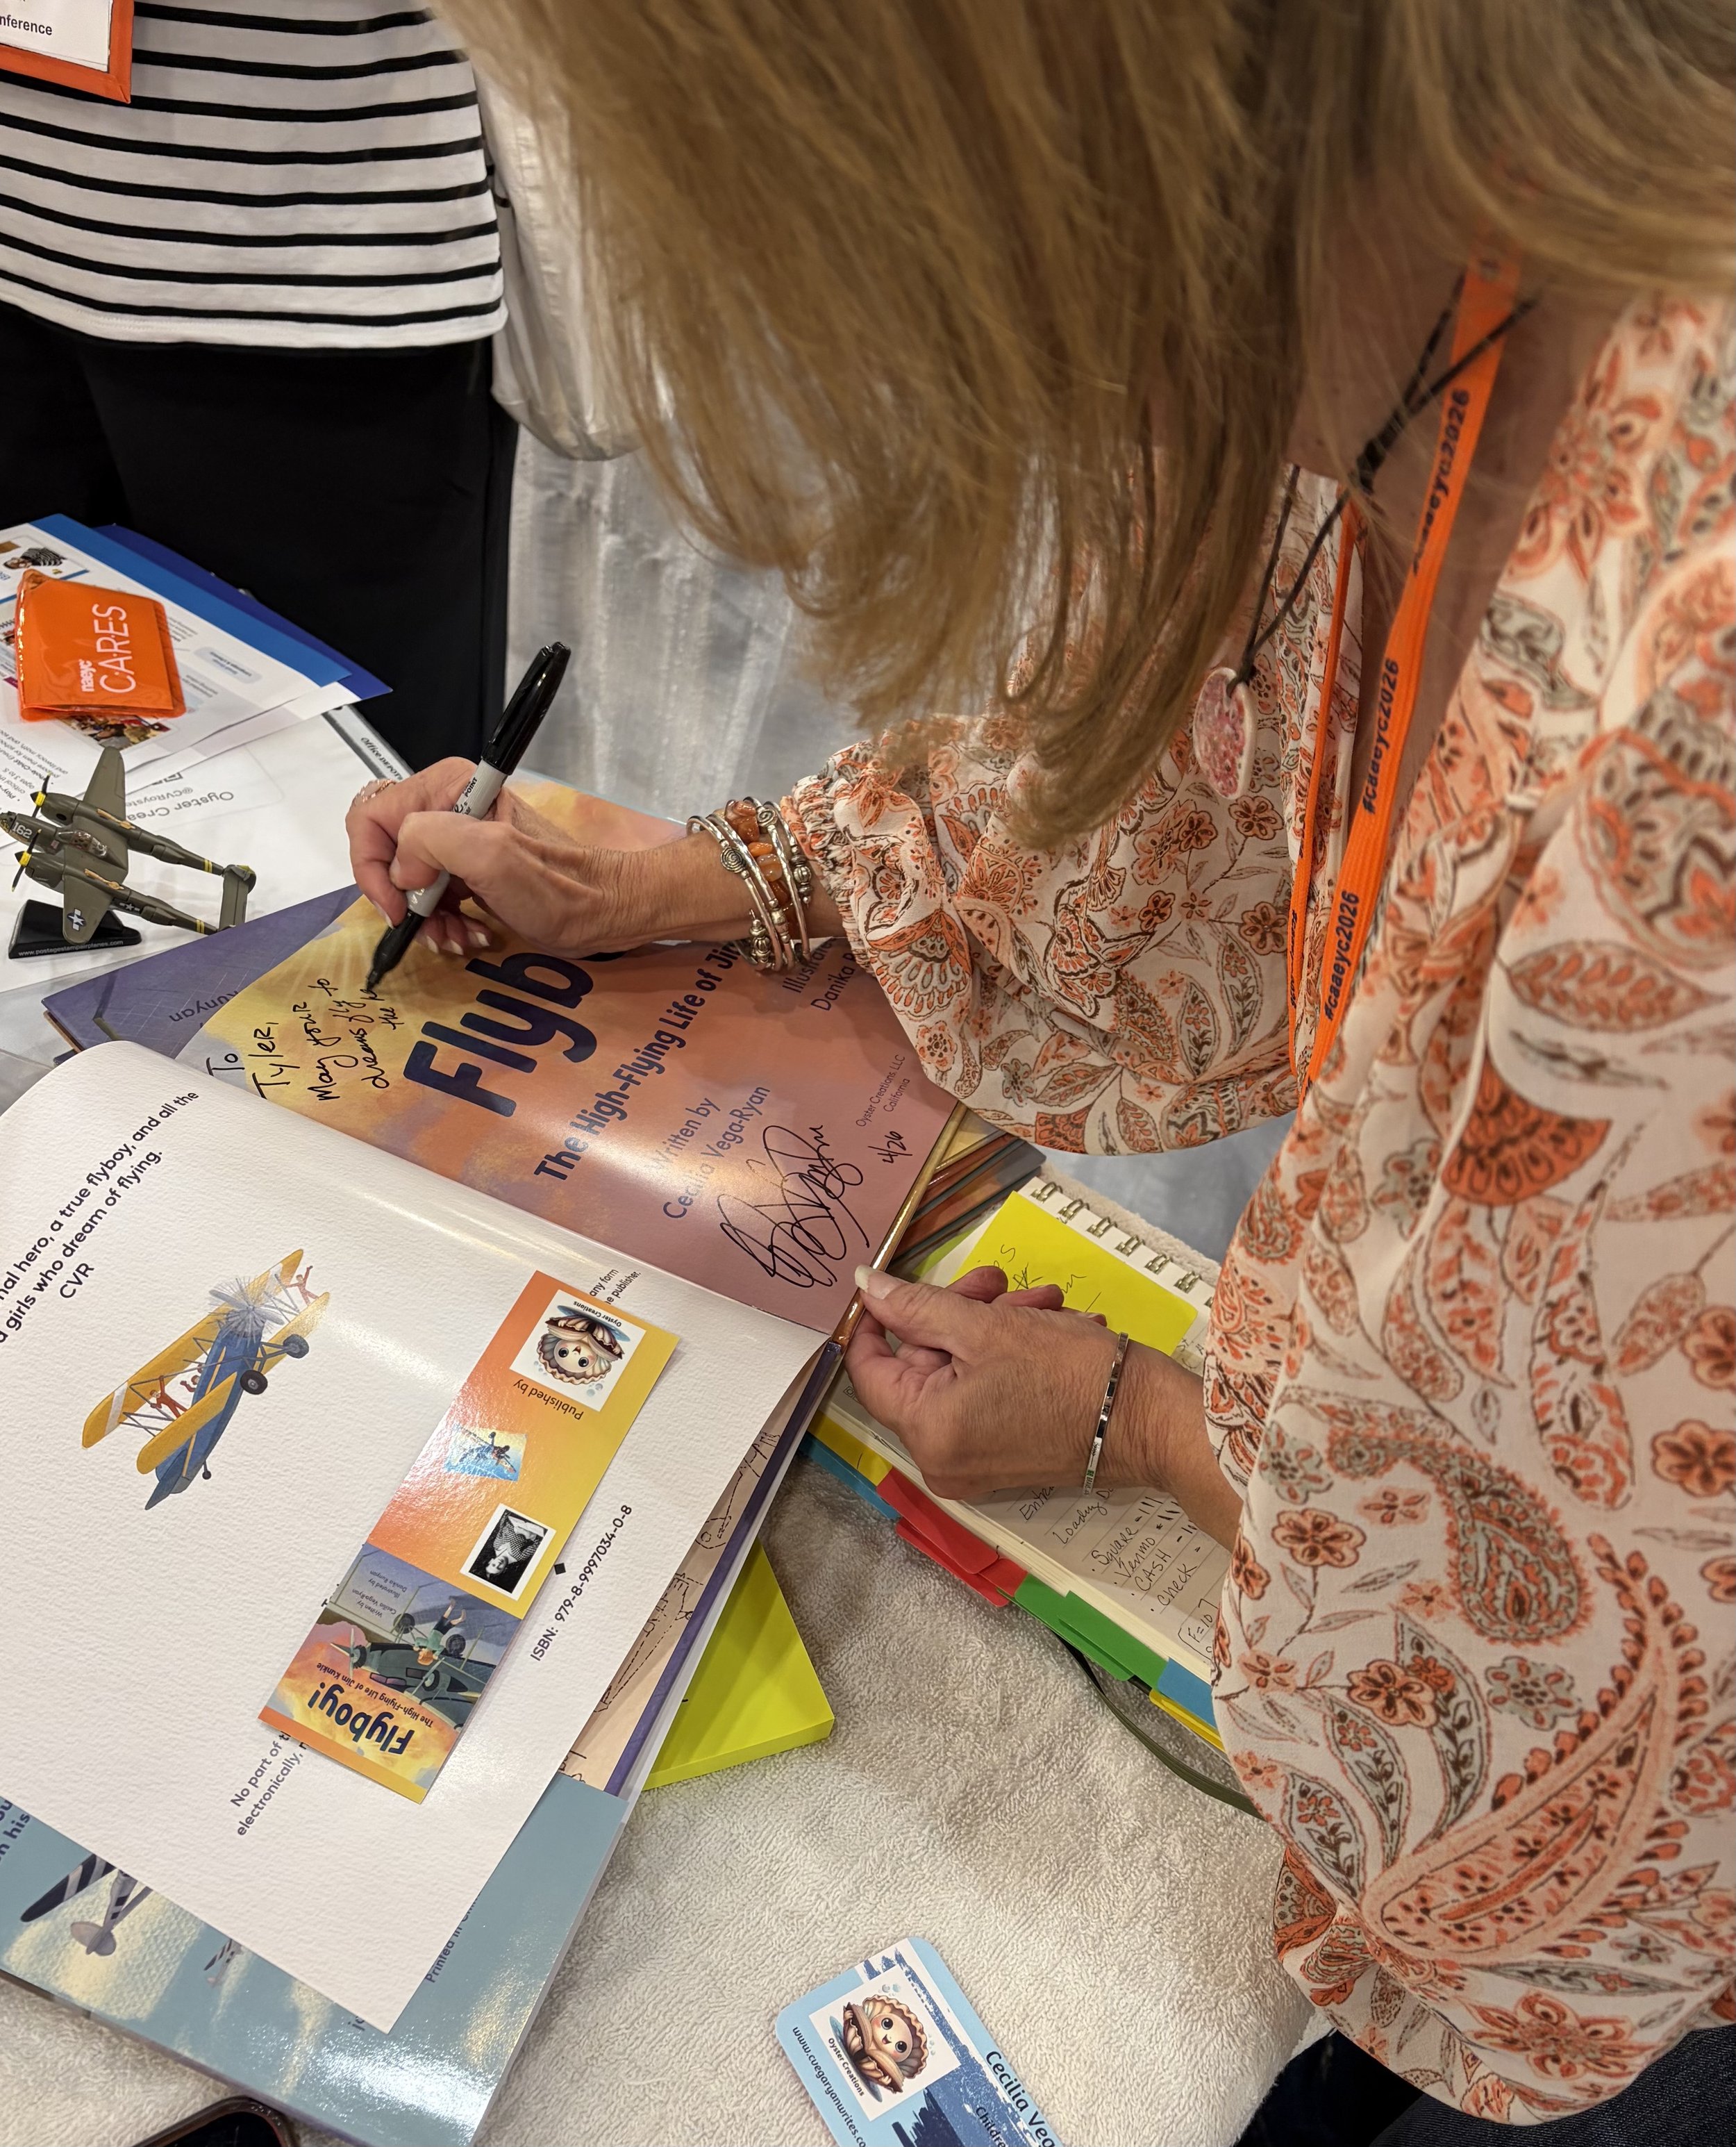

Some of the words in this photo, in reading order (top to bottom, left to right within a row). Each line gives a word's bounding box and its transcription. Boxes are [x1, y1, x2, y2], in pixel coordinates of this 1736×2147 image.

[361, 737, 382, 758] Office
[174, 791, 235, 811] Oyster
[465, 777, 478, 797] POINT
[13, 822, 33, 839] 162
[18, 939, 124, 957] www.postagestampairplanes.com
[1324, 890, 1360, 1022] #caaeyc2026
[810, 965, 856, 1011] Danika
[403, 952, 628, 1118] Flyb
[206, 1053, 245, 1077] To
[308, 1054, 359, 1101] May
[534, 1136, 589, 1181] The
[569, 1029, 687, 1136] High-Flying
[659, 993, 706, 1030] Life
[695, 968, 723, 992] of
[856, 1104, 876, 1127] Oyster
[889, 1054, 905, 1071] LLC
[883, 1078, 911, 1113] California
[685, 1097, 721, 1118] by
[700, 1086, 771, 1158] Vega-Ryan
[13, 1234, 56, 1273] hero,
[50, 1220, 64, 1232] a
[59, 1187, 91, 1218] true
[85, 1143, 137, 1187] flyboy,
[132, 1116, 161, 1142] and
[158, 1103, 178, 1119] all
[174, 1091, 199, 1108] the
[6, 1294, 37, 1332] girls
[32, 1259, 65, 1292] who
[62, 1208, 108, 1258] dream
[104, 1187, 122, 1207] of
[117, 1149, 163, 1191] flying.
[59, 1262, 95, 1299] CVR
[589, 1281, 606, 1297] any
[601, 1268, 619, 1283] form
[614, 1270, 642, 1298] publisher.
[573, 1301, 602, 1318] Creations
[602, 1314, 622, 1327] Oyster
[513, 1379, 531, 1394] by
[528, 1387, 584, 1420] Published
[389, 1579, 408, 1593] Danika
[530, 1626, 559, 1661] ISBN:
[554, 1504, 632, 1622] 979-8-9997034-0-8
[365, 1603, 383, 1618] Written
[379, 1602, 397, 1615] Cecilia
[317, 1662, 342, 1680] Kunkle
[342, 1674, 356, 1688] Jim
[356, 1681, 364, 1691] of
[365, 1686, 378, 1700] Life
[308, 1682, 415, 1755] Flyboy!
[378, 1692, 419, 1721] High-Flying
[419, 1716, 434, 1728] The
[230, 1787, 251, 1807] No
[248, 1758, 272, 1789] part
[269, 1741, 283, 1757] of
[237, 1749, 303, 1837] electronically,
[3, 1813, 31, 1839] his
[828, 2037, 844, 2062] Oyster
[842, 2062, 866, 2097] Creations
[985, 2050, 1029, 2112] Cecilia
